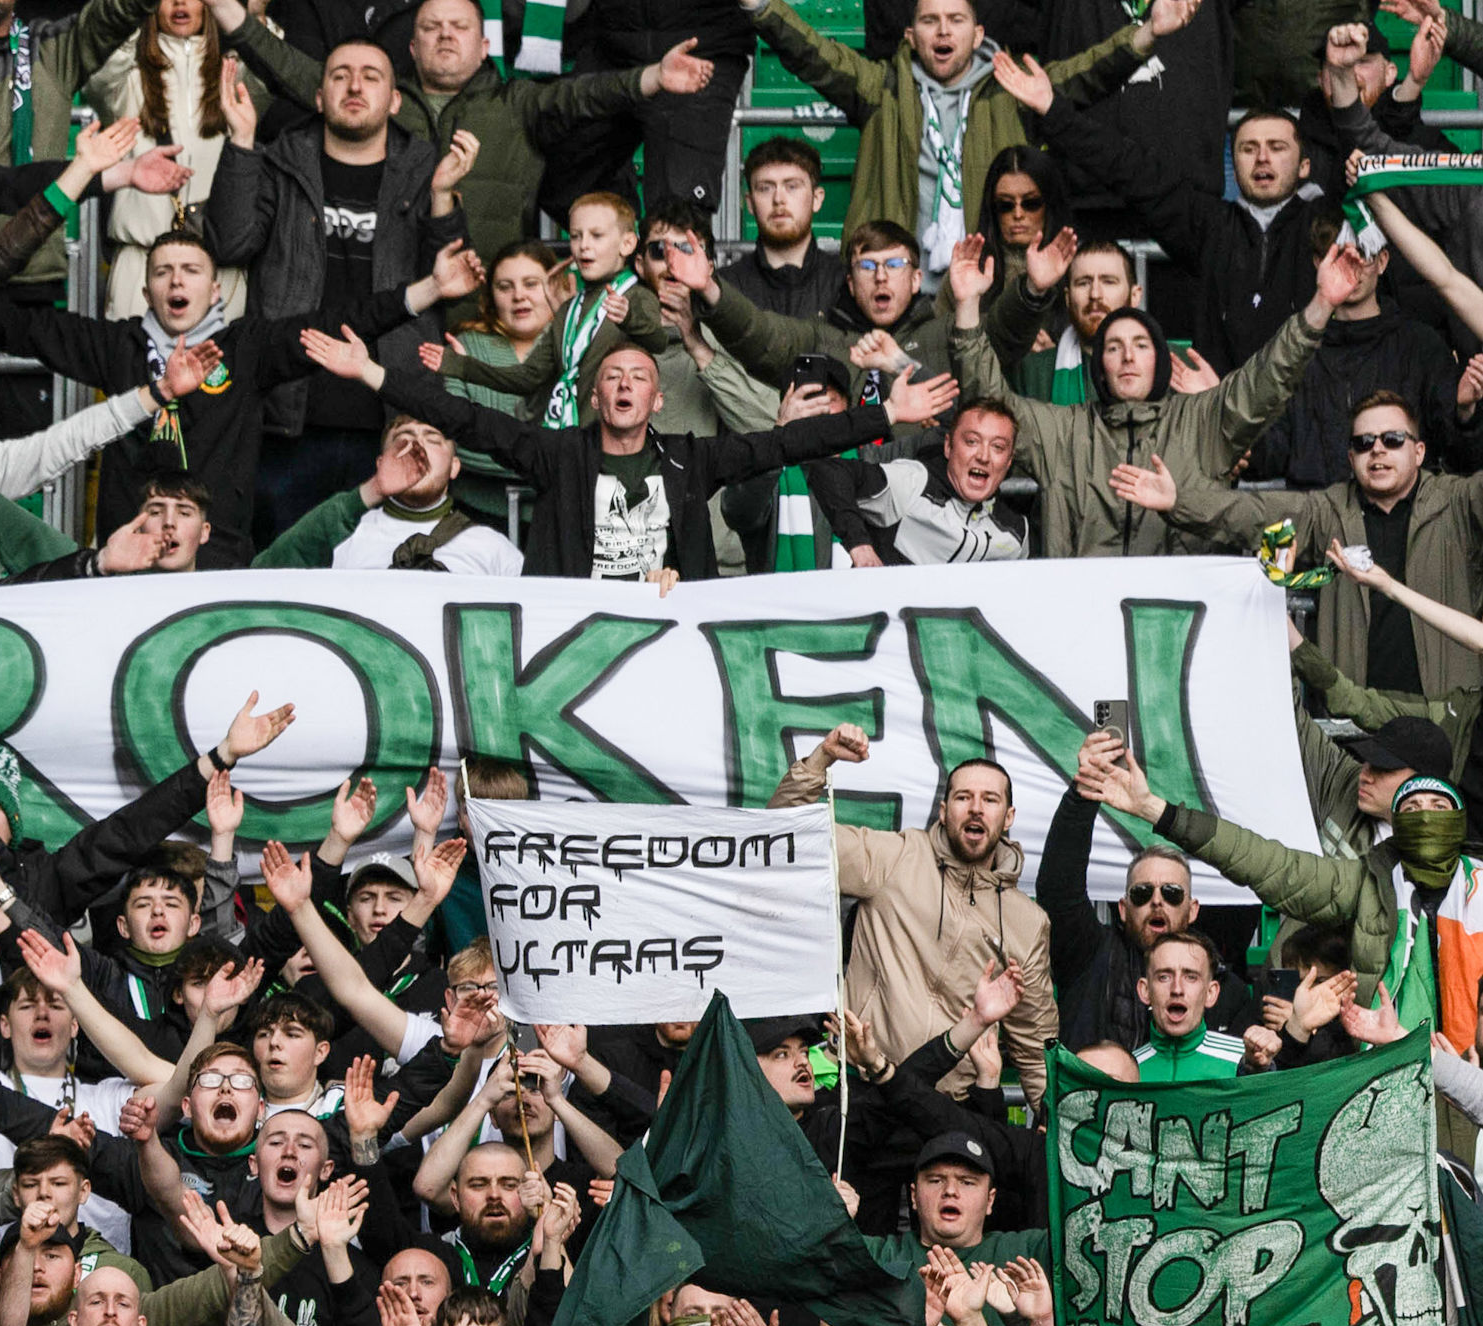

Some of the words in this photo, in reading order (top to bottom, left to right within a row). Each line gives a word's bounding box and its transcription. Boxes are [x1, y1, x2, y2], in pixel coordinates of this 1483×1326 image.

[484, 830, 795, 882] FREEDOM
[490, 884, 602, 930] FOR
[496, 934, 725, 995] ULTRAS
[1056, 1086, 1305, 1215] CANT
